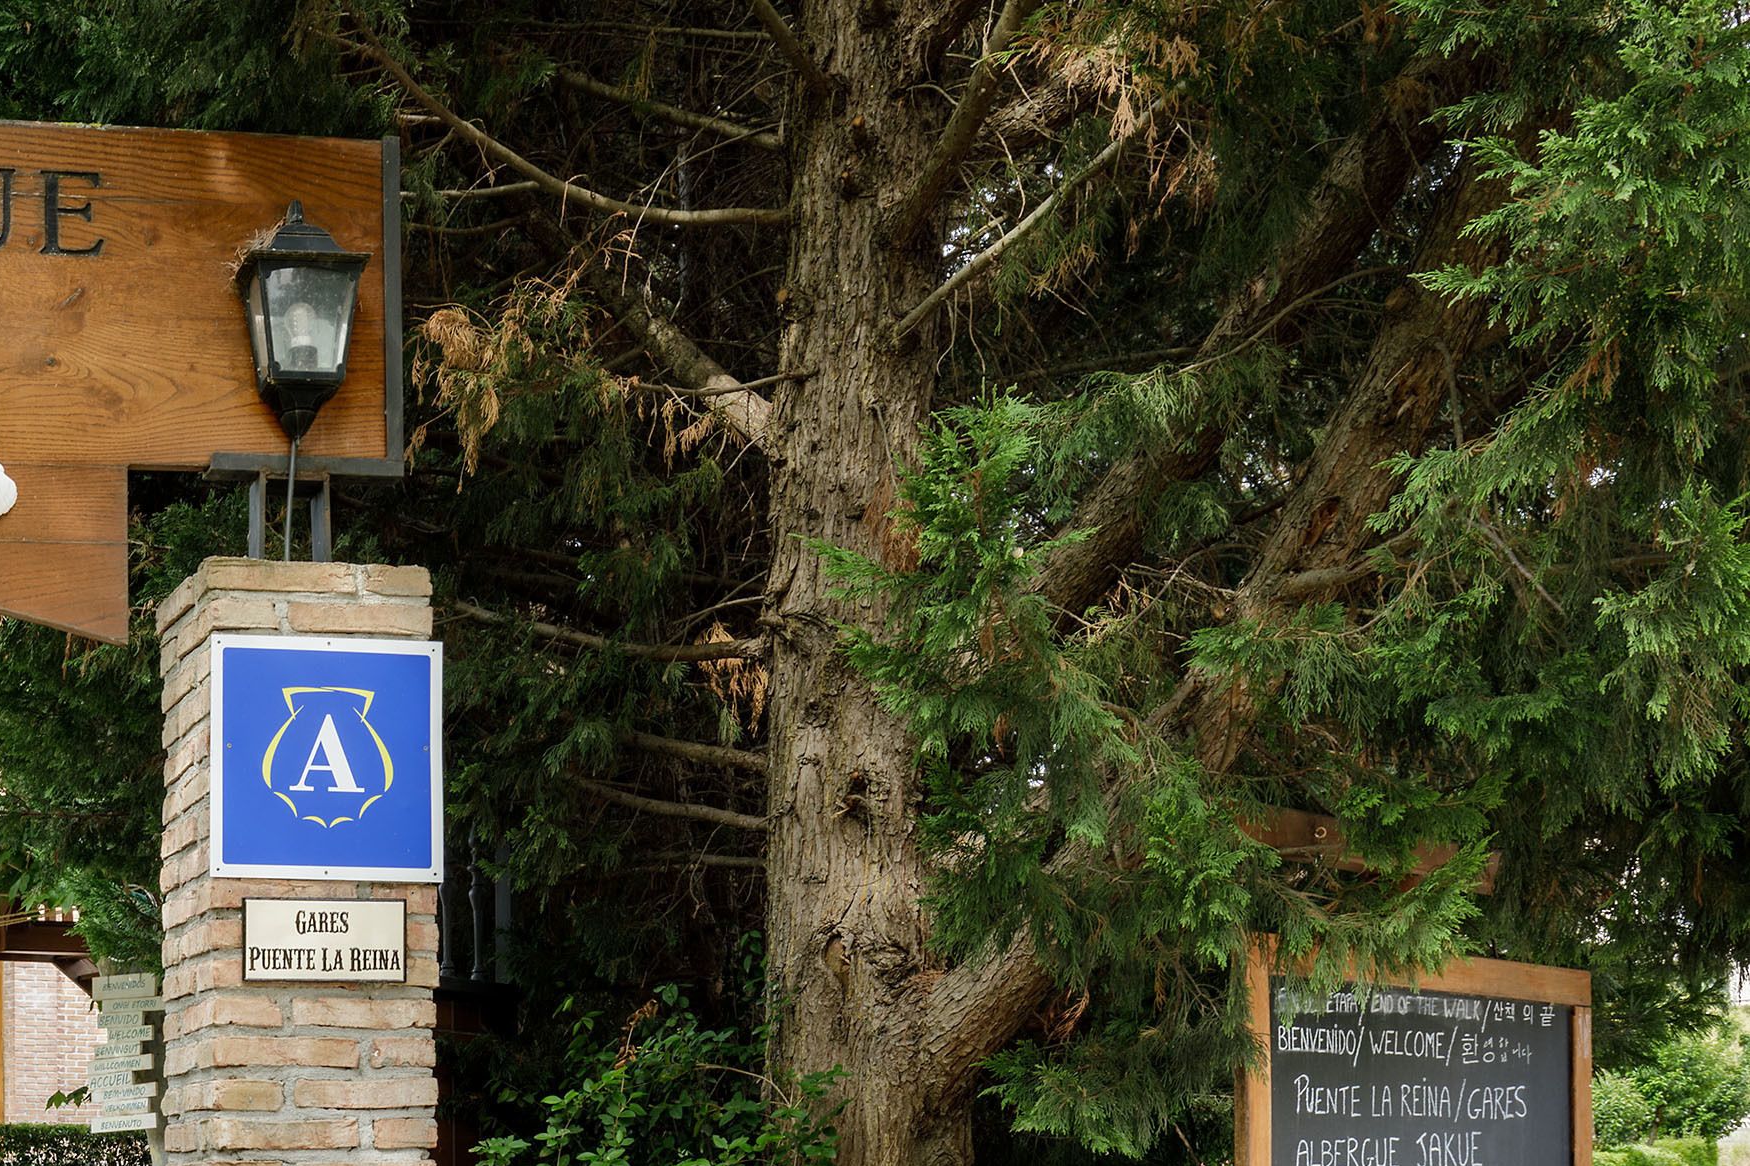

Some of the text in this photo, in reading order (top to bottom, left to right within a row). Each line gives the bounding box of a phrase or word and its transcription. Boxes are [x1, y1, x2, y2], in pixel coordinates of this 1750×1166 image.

[289, 714, 365, 793] A
[295, 909, 350, 935] GARES
[248, 946, 401, 972] PUENTE LA REINA
[1397, 995, 1411, 1015] OF
[1417, 996, 1439, 1017] THE
[98, 1014, 139, 1026] BENVIDO
[108, 1027, 151, 1040] WELCOME
[89, 1072, 131, 1089] ACCUEIL
[1294, 1074, 1361, 1117] PUENTE
[1371, 1085, 1392, 1117] LA
[100, 1119, 142, 1131] BENVENUTO
